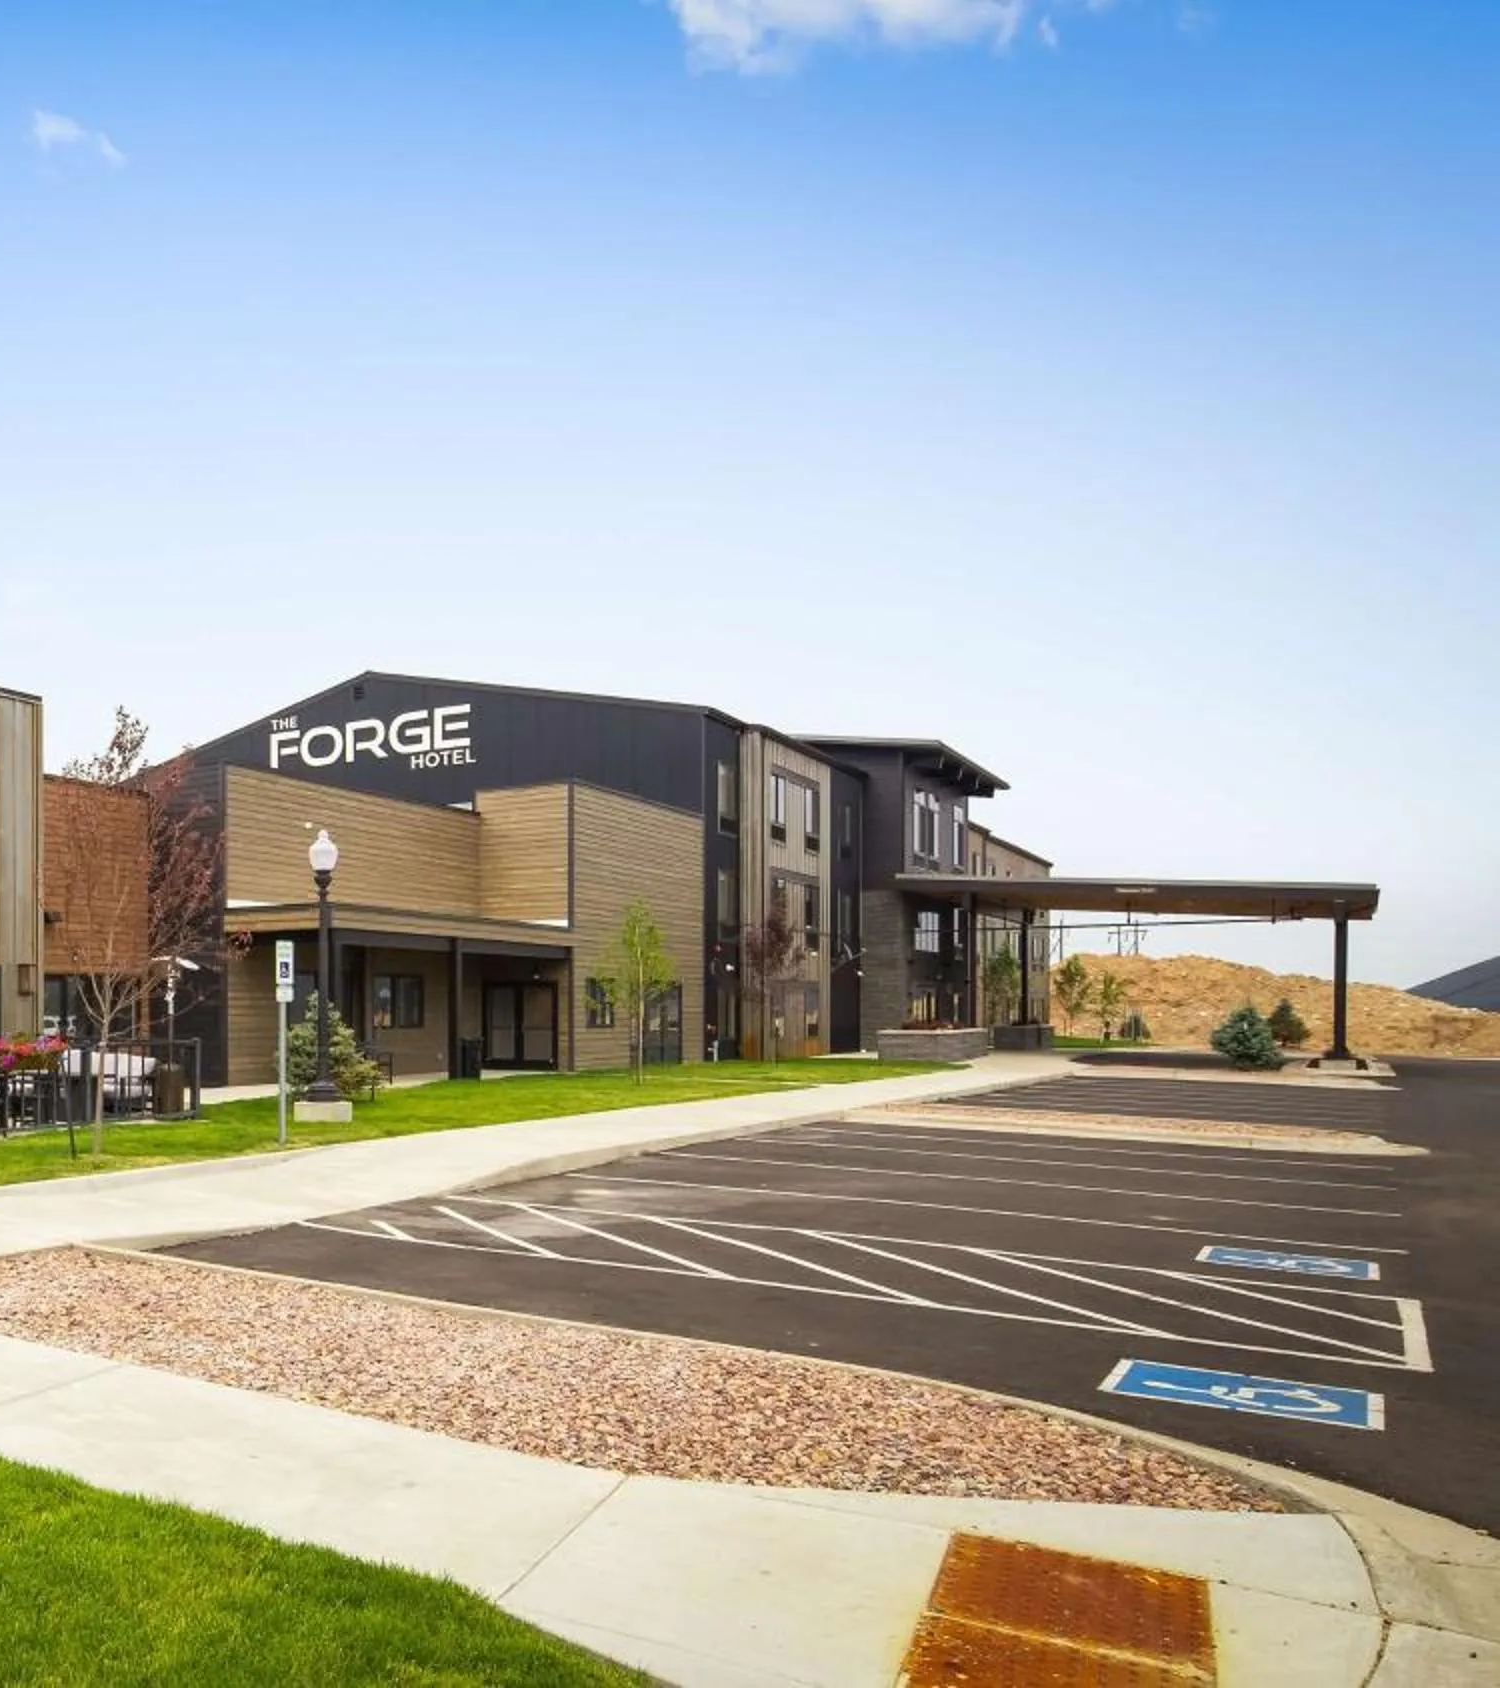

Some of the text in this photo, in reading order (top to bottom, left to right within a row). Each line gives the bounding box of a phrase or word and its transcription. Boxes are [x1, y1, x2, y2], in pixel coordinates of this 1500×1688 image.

[270, 715, 299, 731] THE
[269, 703, 471, 769] FORGE
[410, 749, 477, 770] HOTEL
